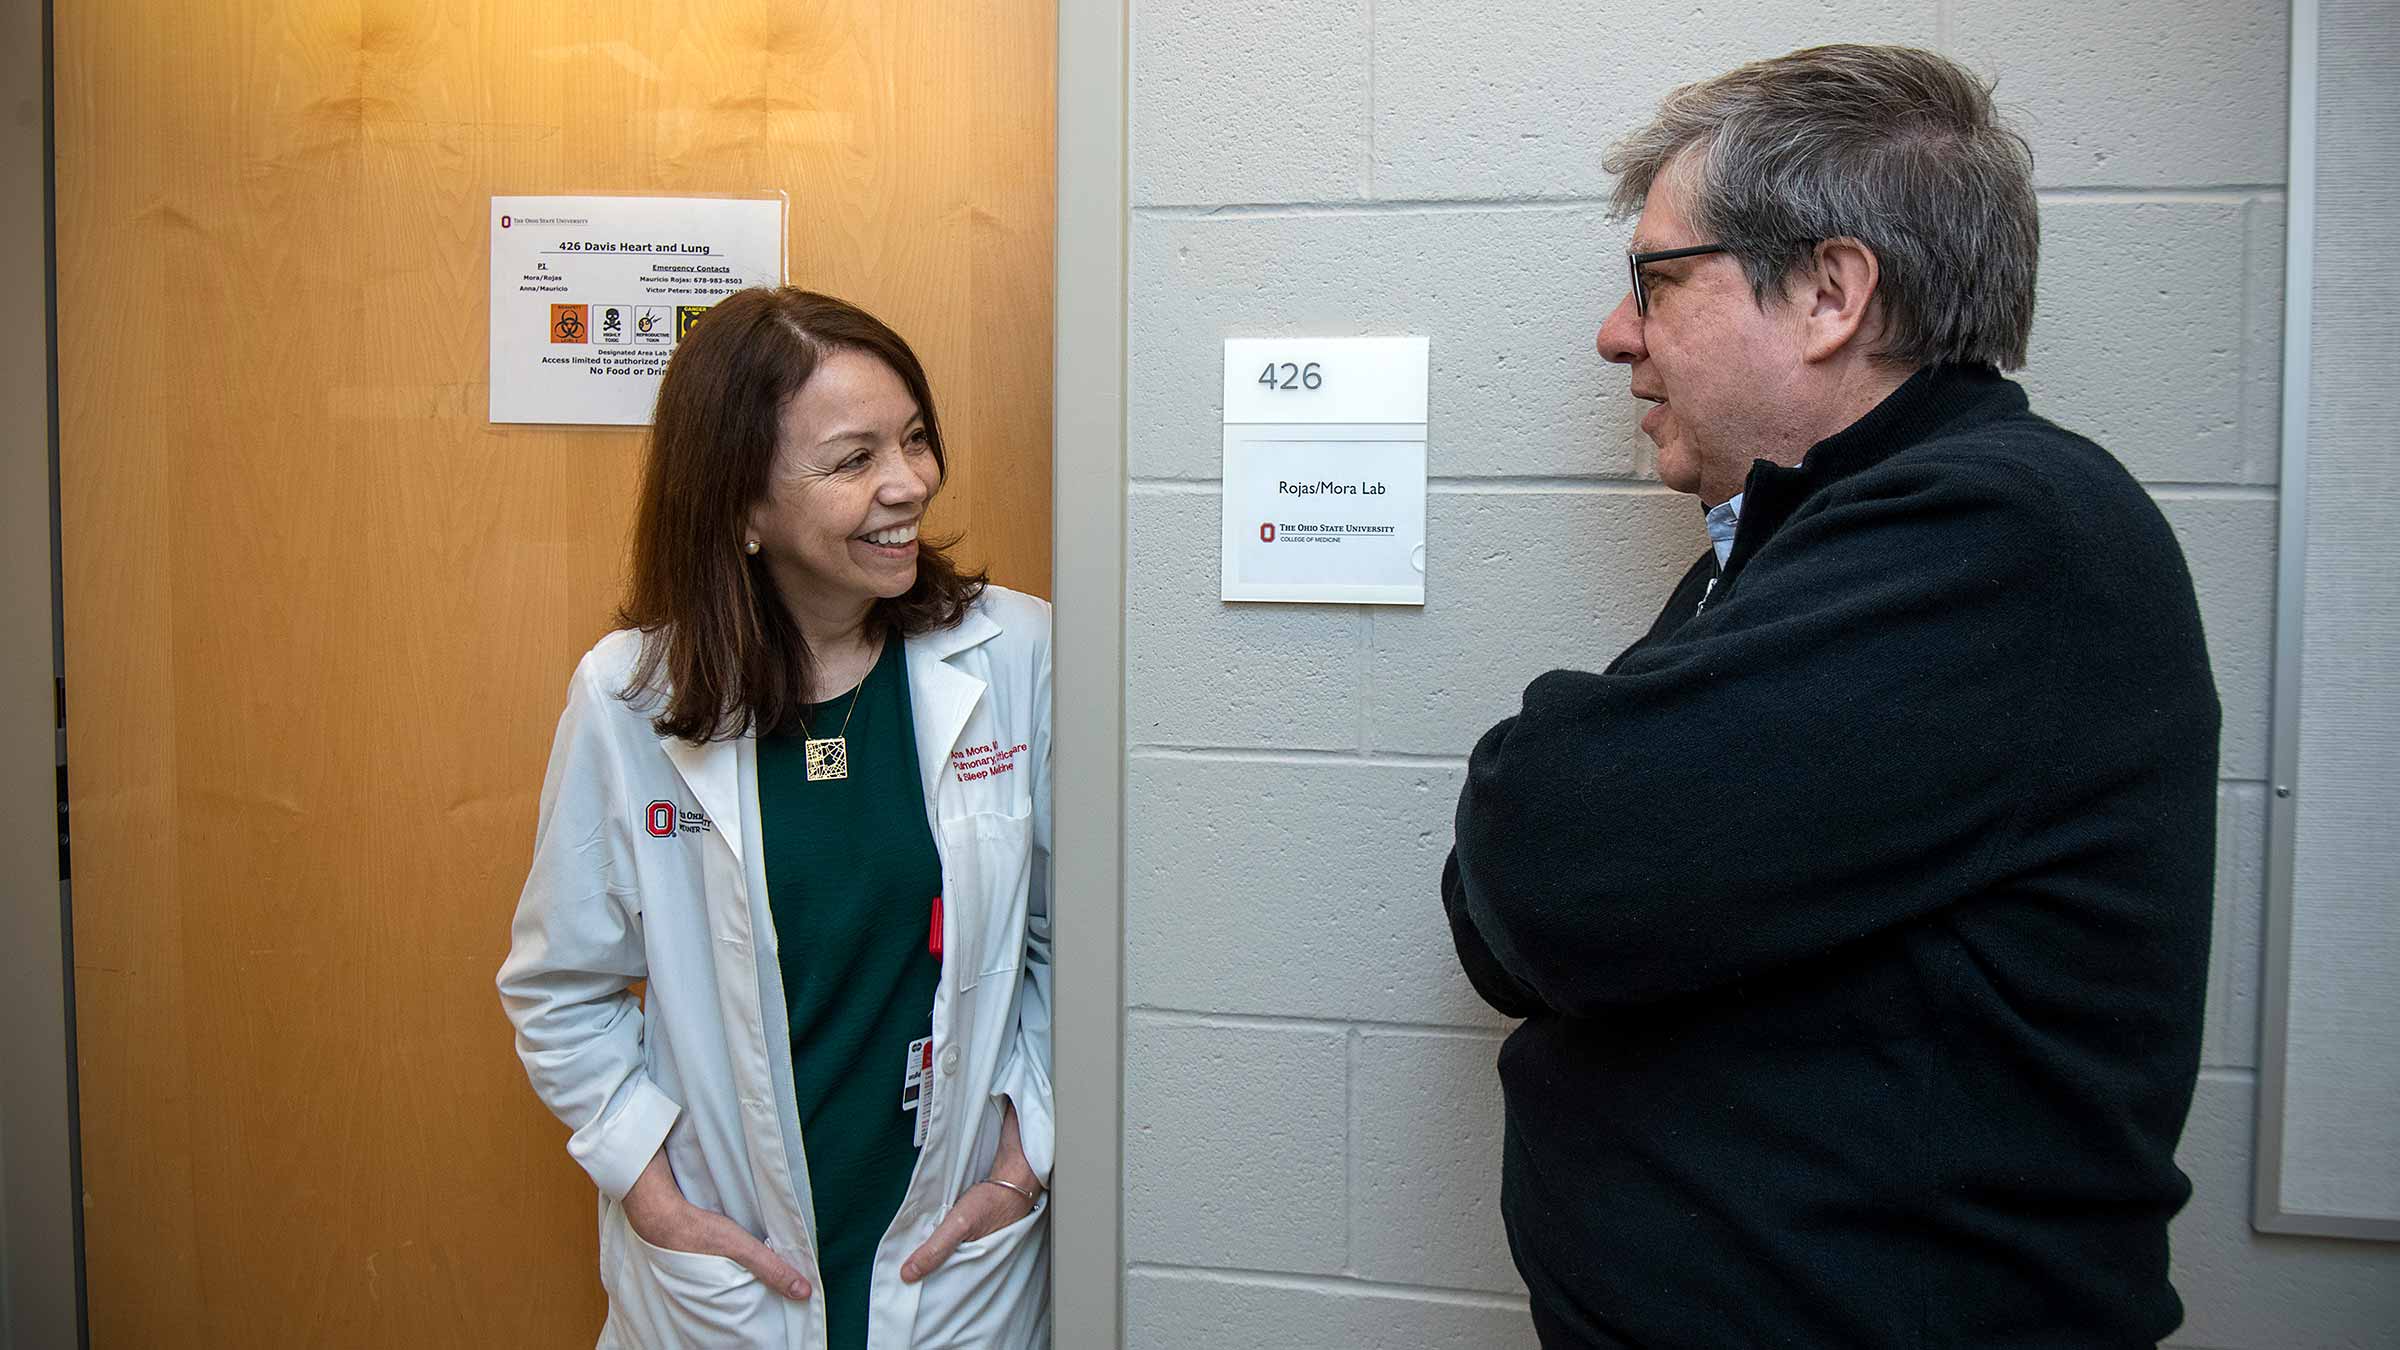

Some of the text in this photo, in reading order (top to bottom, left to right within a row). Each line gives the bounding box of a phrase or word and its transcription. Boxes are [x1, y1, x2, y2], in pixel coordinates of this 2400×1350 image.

[559, 242, 710, 255] 426 Davis Heart and Lung
[652, 264, 730, 273] Emergency Contacts
[523, 274, 562, 282] Mora/Rojas
[542, 356, 570, 364] Access
[572, 356, 601, 364] limited
[590, 367, 604, 375] No
[606, 367, 630, 376] Food
[634, 368, 645, 376] or
[1258, 362, 1323, 390] 426
[1279, 481, 1386, 497] Rojas/Mora Lab
[1280, 524, 1395, 534] THE OHIO STATE UNIVERSITY
[966, 744, 992, 757] Mora,
[963, 770, 988, 782] Sleep
